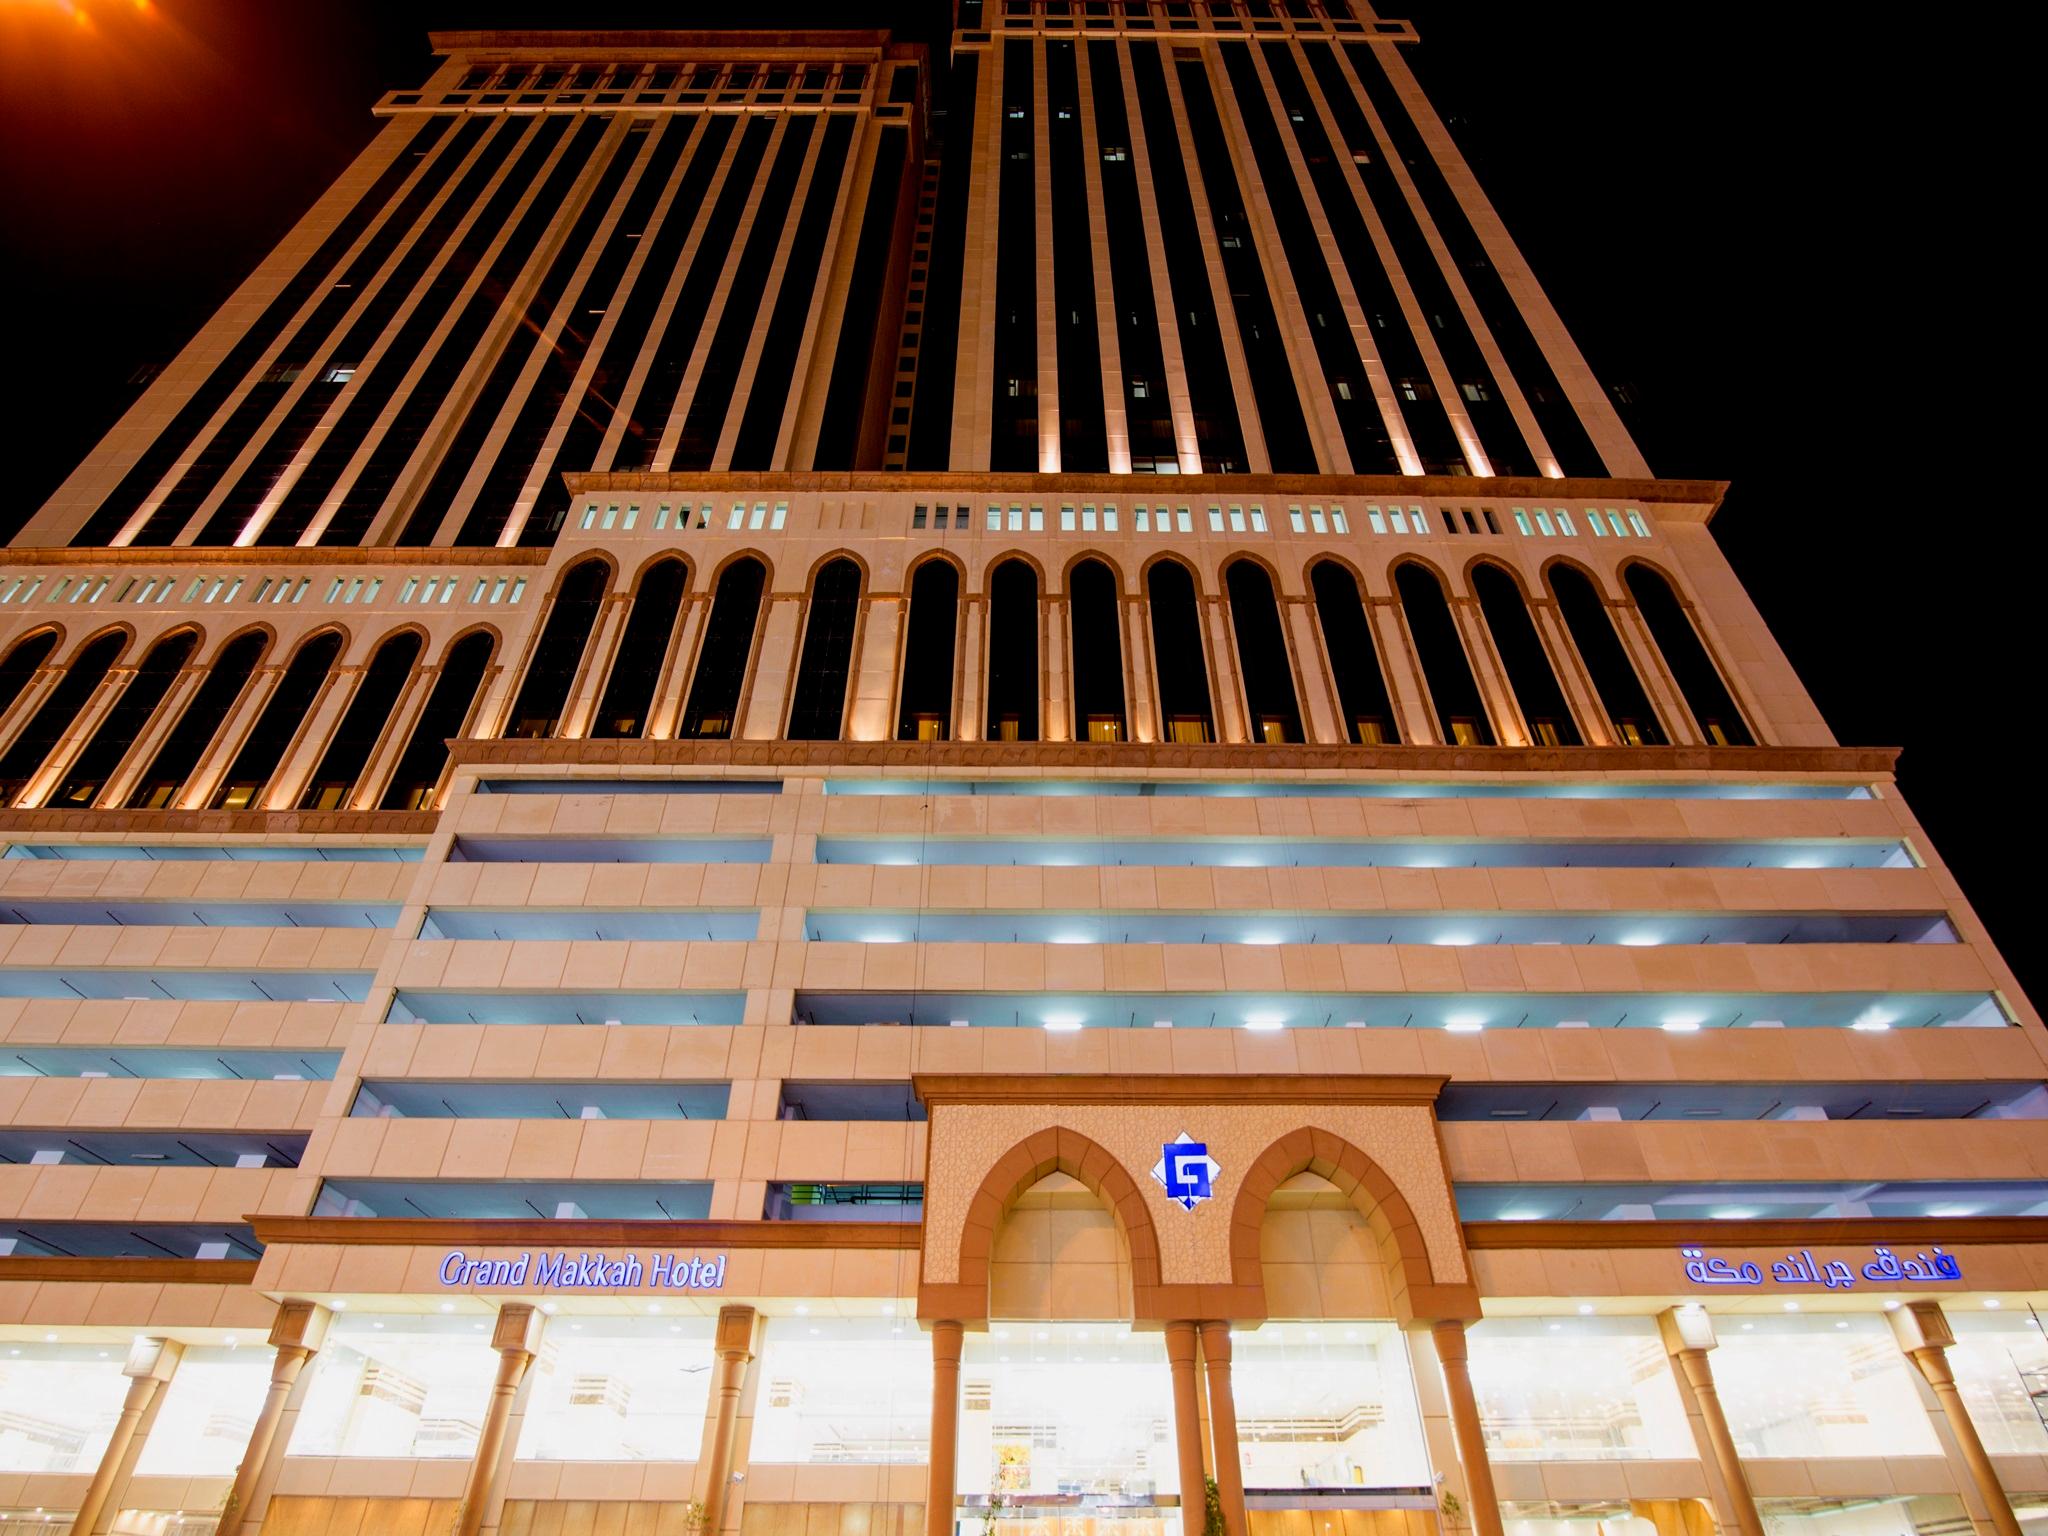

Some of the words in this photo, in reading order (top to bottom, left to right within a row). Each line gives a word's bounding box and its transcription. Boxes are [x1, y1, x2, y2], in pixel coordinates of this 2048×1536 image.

[439, 1251, 531, 1286] Grand
[533, 1252, 643, 1287] Makkah
[649, 1253, 727, 1288] Hotel
[1682, 1248, 1763, 1284] مكة
[1771, 1250, 1855, 1288] جراند
[1861, 1247, 1962, 1281] فندق
